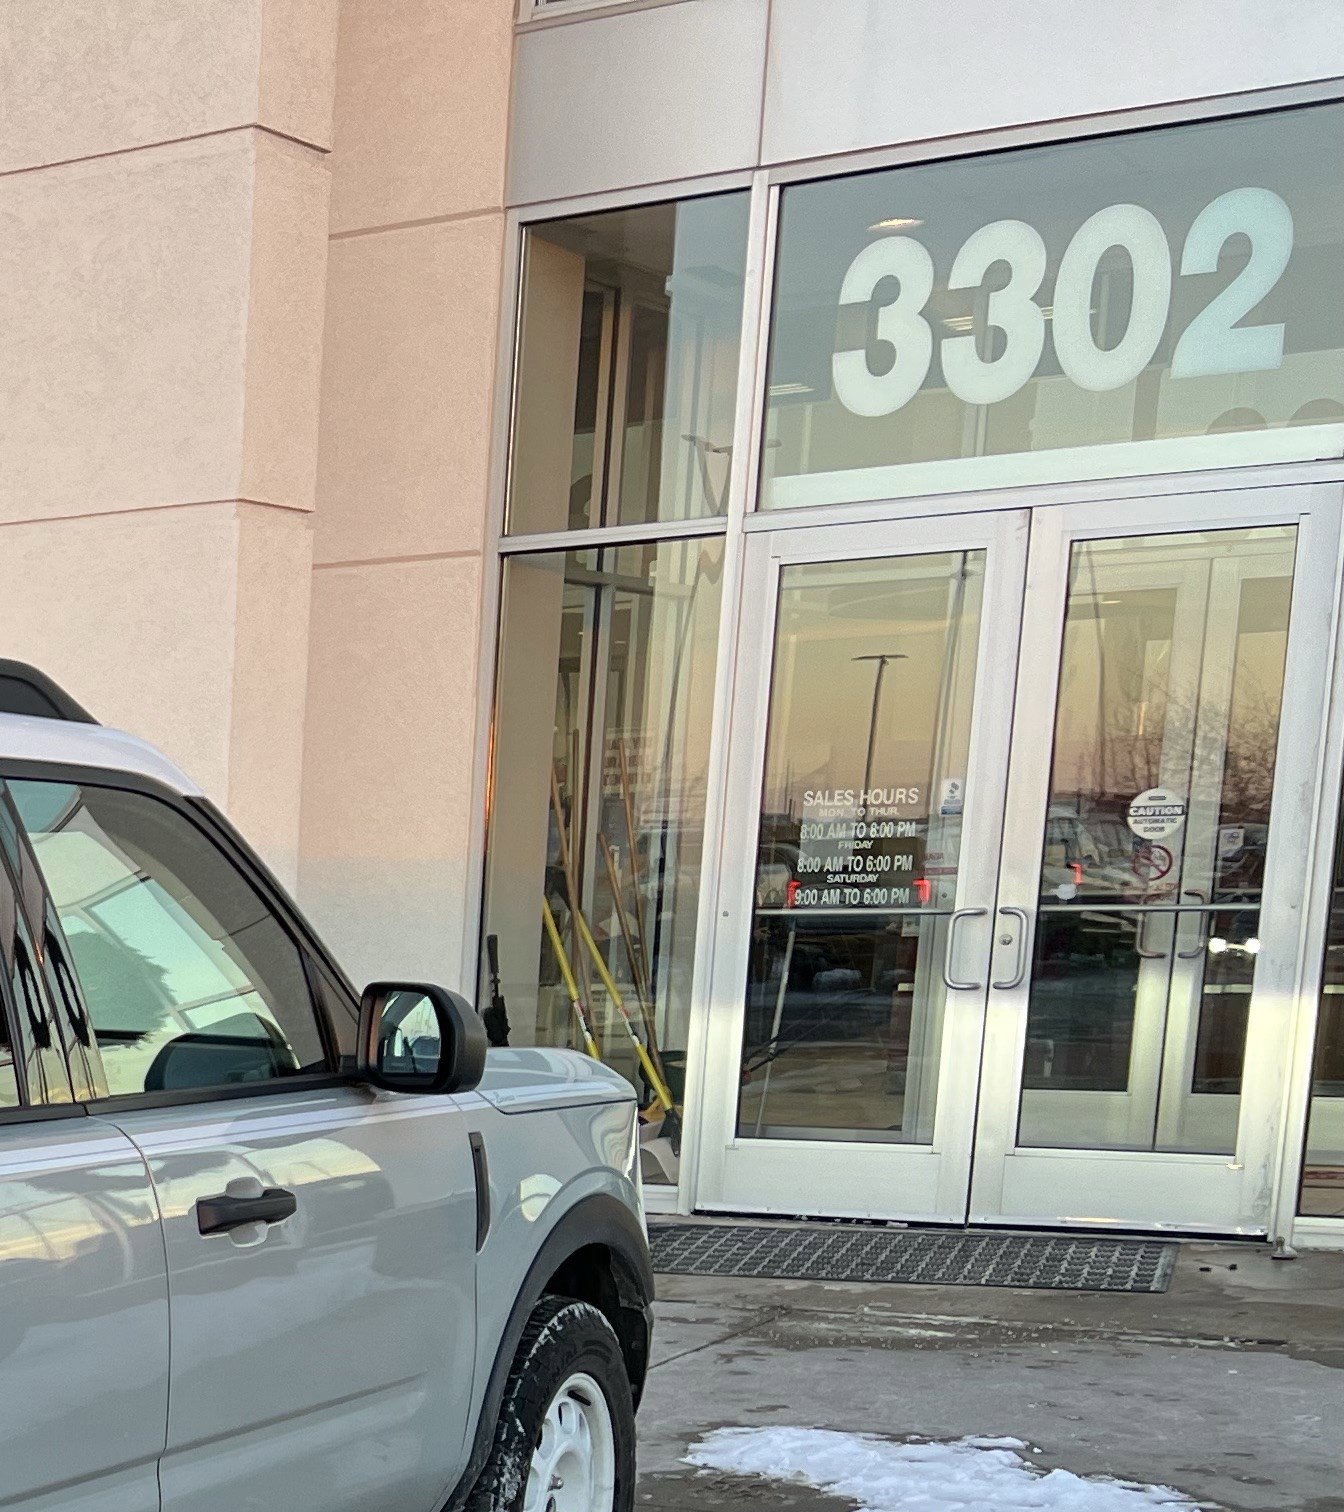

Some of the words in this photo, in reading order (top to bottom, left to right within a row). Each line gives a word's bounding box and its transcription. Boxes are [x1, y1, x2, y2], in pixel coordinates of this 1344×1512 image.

[832, 186, 1294, 417] 3302
[803, 789, 855, 806] SALES
[859, 788, 919, 805] HOURS
[1130, 806, 1183, 816] CAUTION
[800, 823, 824, 839] 8:00
[826, 823, 847, 838] AM
[851, 822, 866, 838] TO
[869, 822, 894, 838] 8:00
[897, 821, 916, 837] PM
[838, 840, 874, 849] FRIDAY
[797, 857, 821, 873] 8:00
[823, 856, 844, 872] AM
[847, 856, 863, 872] TO
[866, 855, 891, 871] 6:00
[893, 855, 913, 871] PM
[826, 874, 879, 883] SATURDAY
[794, 889, 818, 905] 9:00
[820, 889, 840, 905] AM
[844, 888, 860, 904] TO
[863, 888, 888, 904] 6:00
[890, 887, 910, 904] PM
